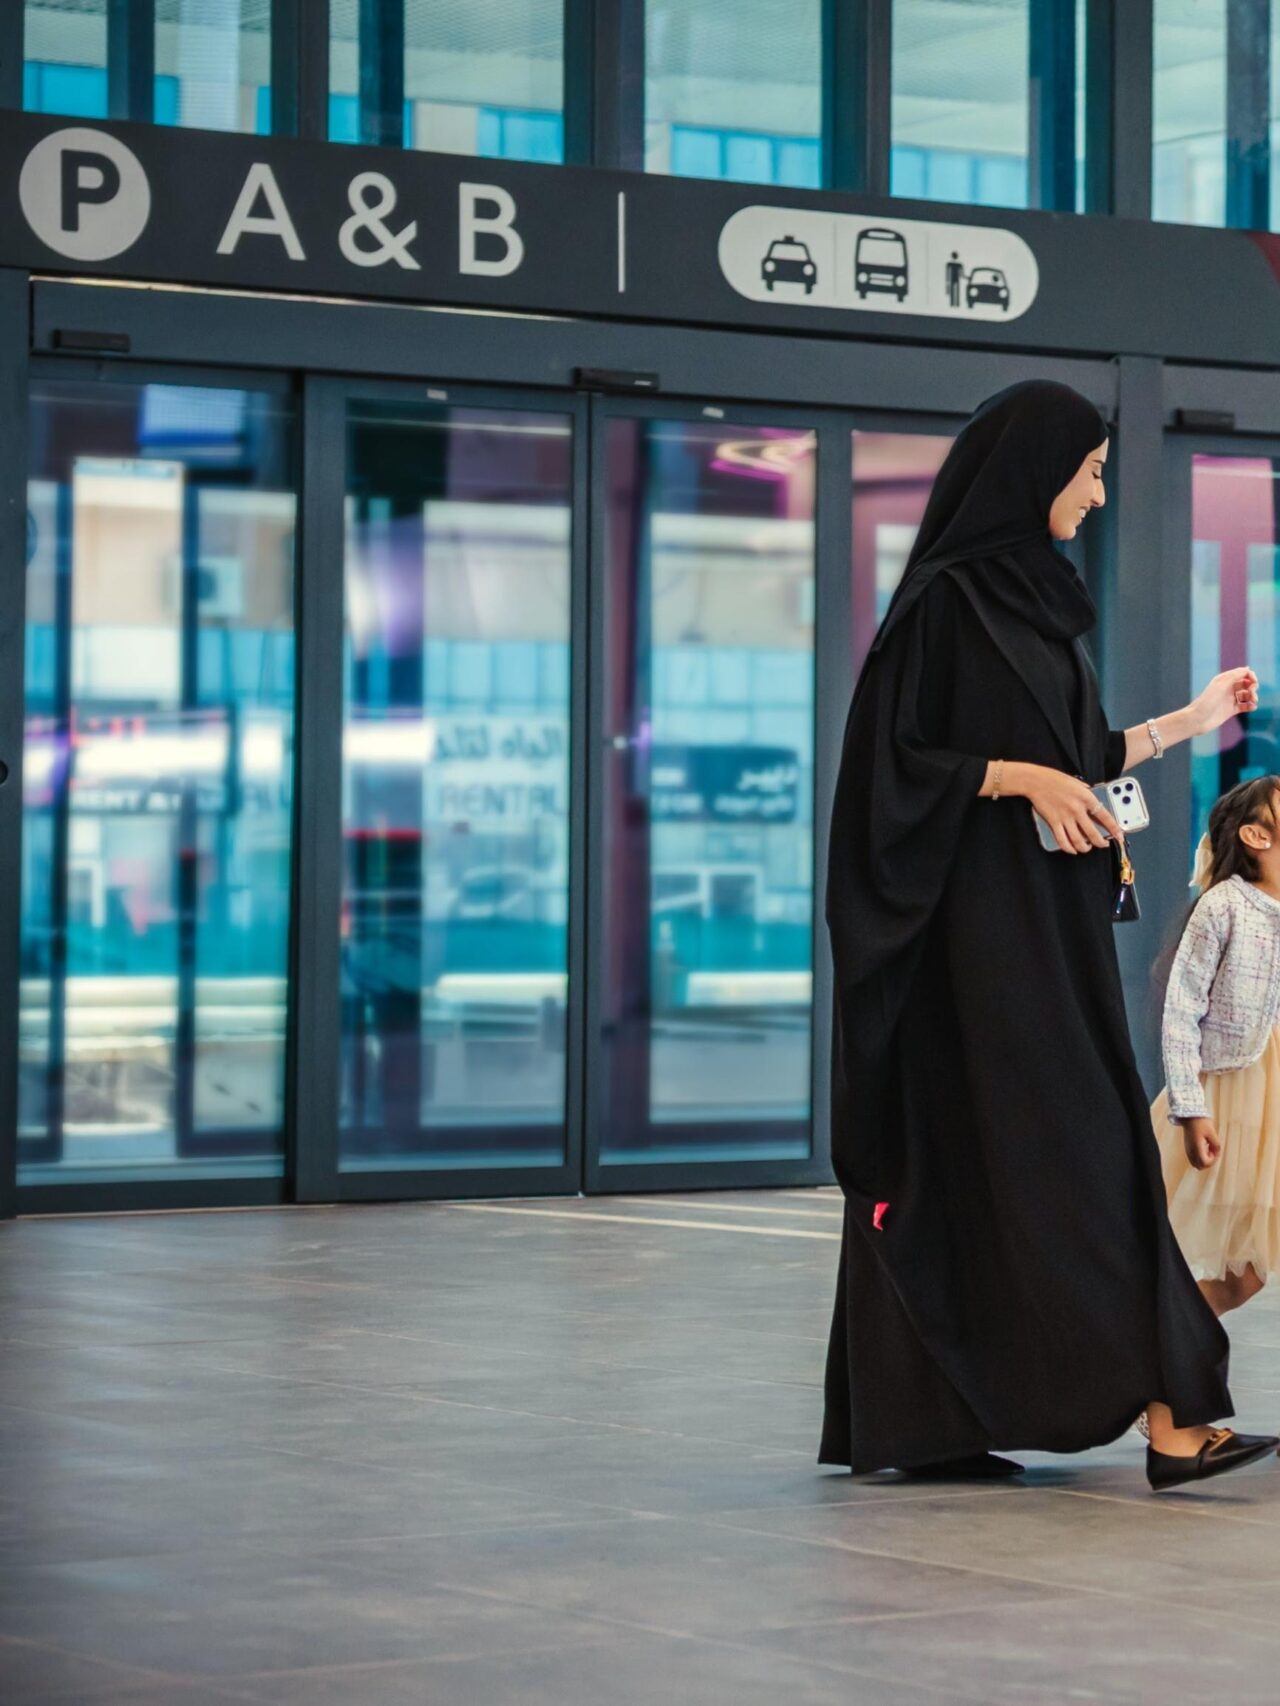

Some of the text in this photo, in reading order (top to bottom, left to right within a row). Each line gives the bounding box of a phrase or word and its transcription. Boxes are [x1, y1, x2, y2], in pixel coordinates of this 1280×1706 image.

[60, 148, 524, 278] P A & B
